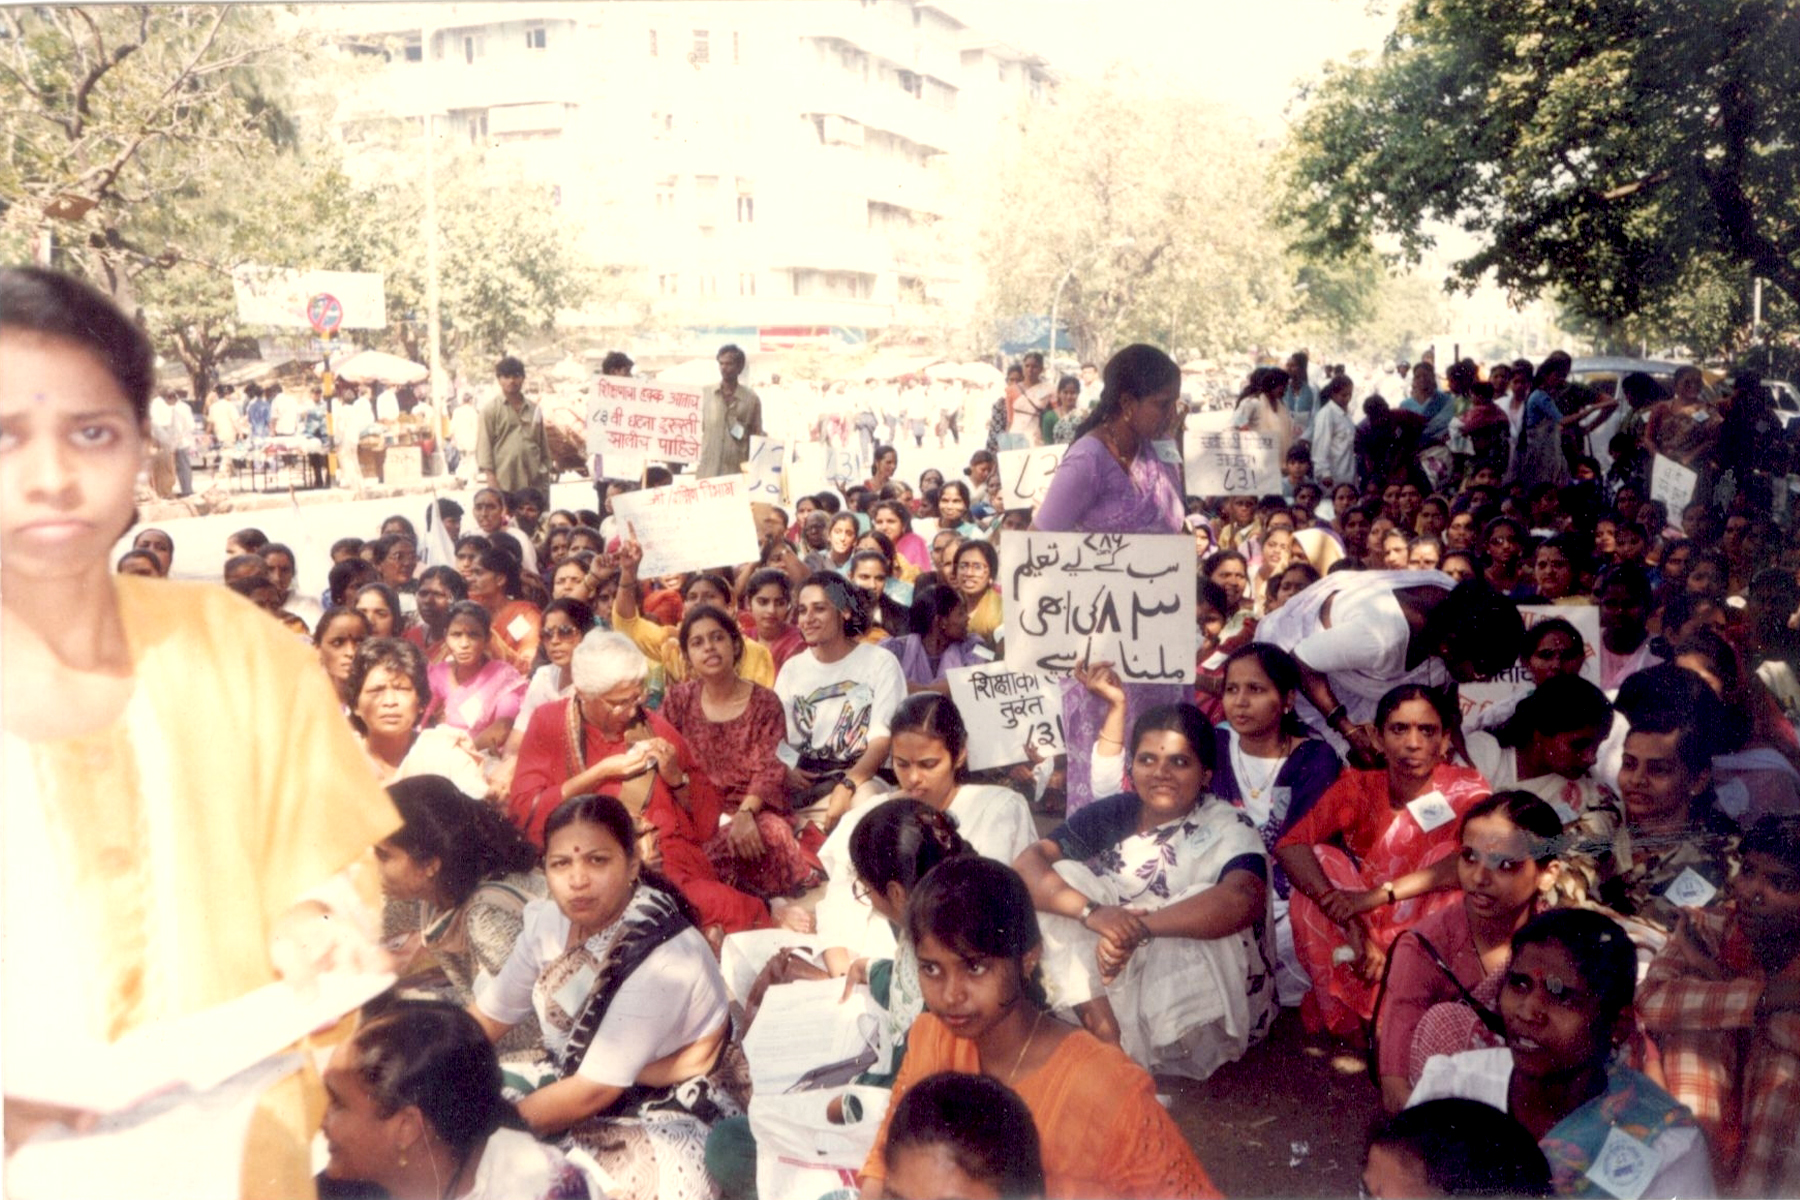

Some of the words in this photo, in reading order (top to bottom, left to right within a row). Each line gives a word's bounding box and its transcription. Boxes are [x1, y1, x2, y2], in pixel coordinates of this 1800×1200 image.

[1013, 537, 1060, 602] تعلیم
[1094, 543, 1131, 573] کے
[1127, 561, 1180, 584] سب
[1119, 640, 1186, 680] ملنا
[1000, 695, 1045, 730] तुरंत
